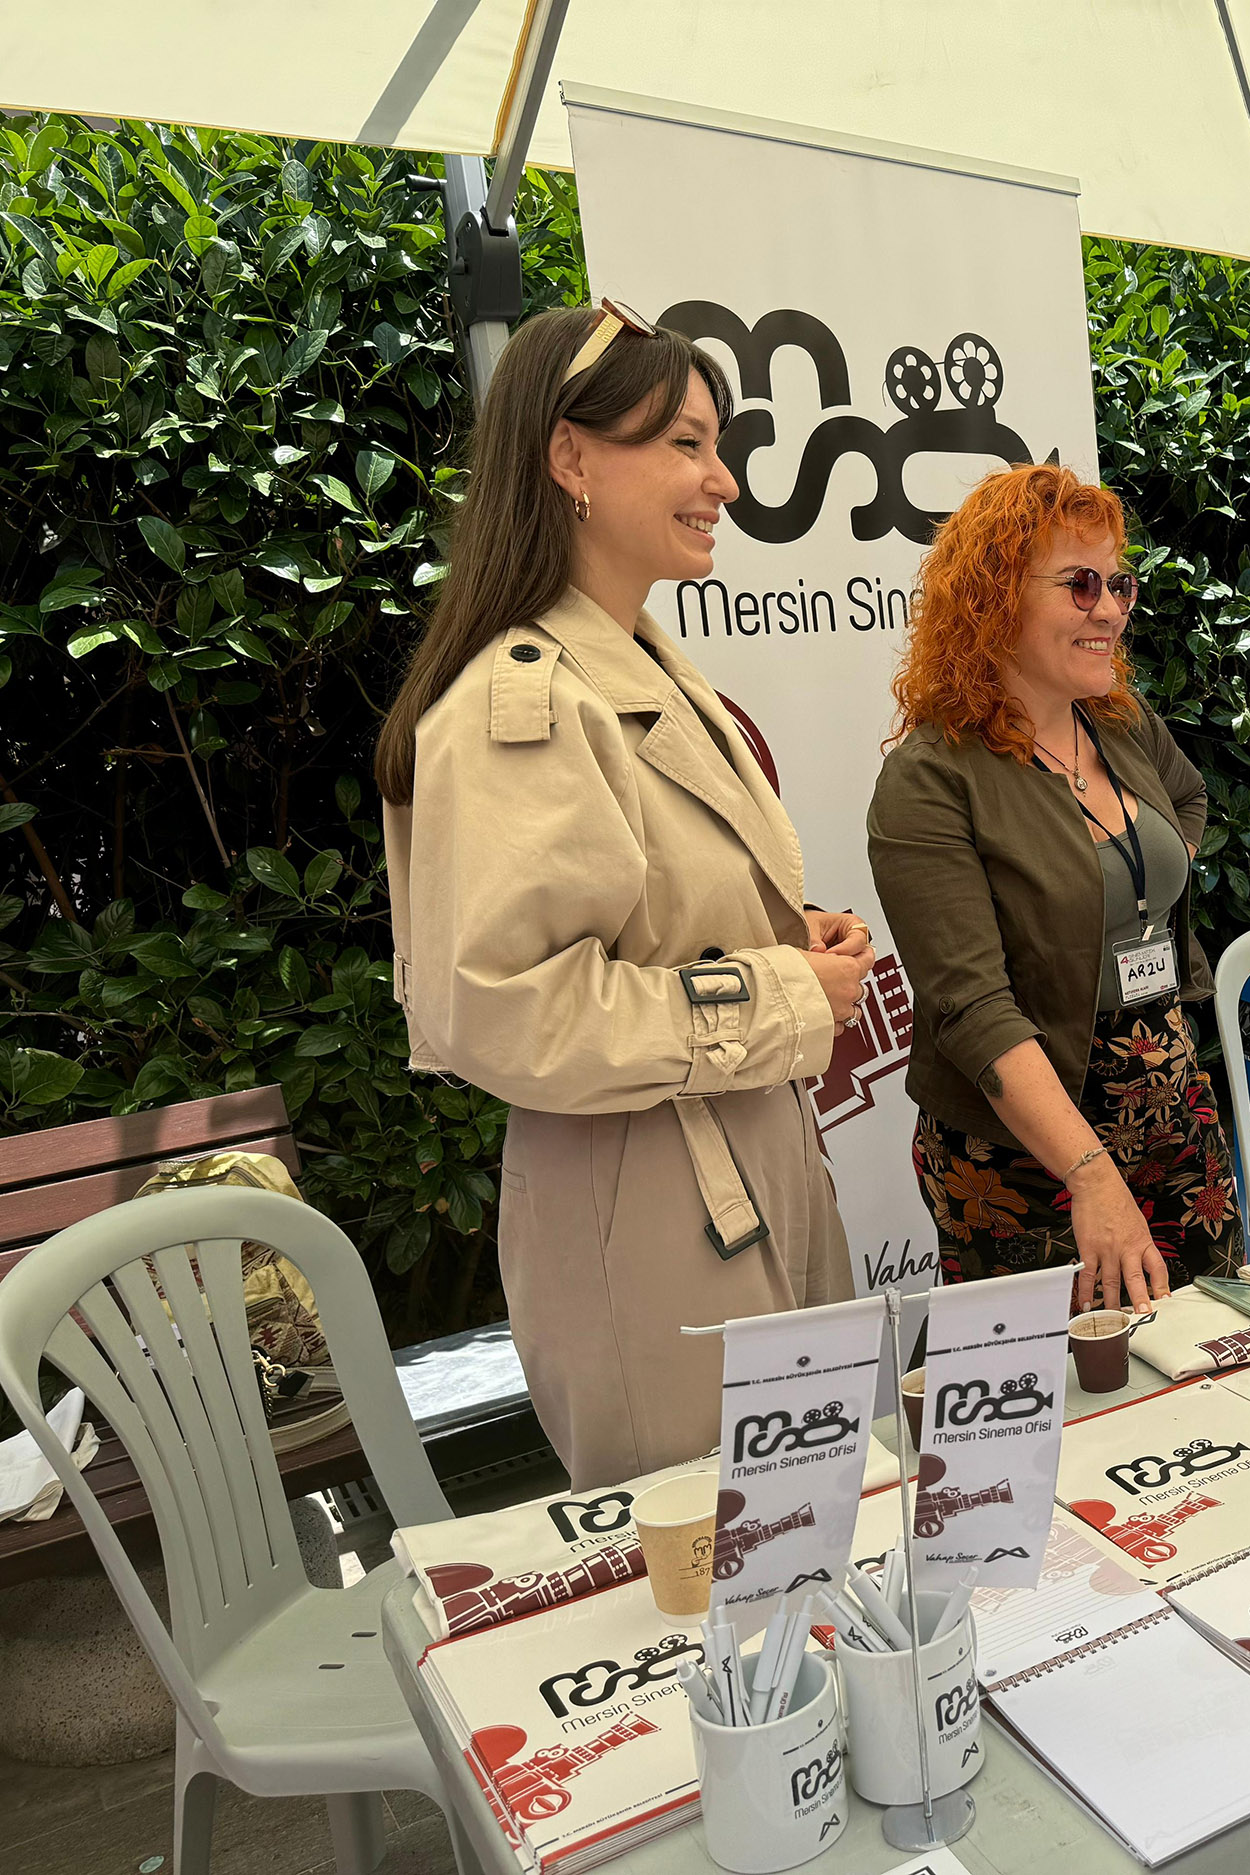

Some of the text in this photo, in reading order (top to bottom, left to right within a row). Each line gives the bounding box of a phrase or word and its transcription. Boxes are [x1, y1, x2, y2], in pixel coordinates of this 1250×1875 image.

[676, 576, 925, 638] Mersin Sine
[933, 1419, 1052, 1444] Mersin Sinema Ofisi
[732, 1442, 857, 1480] Mersin Sinema Ofisi
[1139, 1485, 1191, 1506] Mersin
[1188, 1469, 1239, 1488] Sinema
[561, 1682, 684, 1734] Mersin Sine
[938, 1726, 962, 1744] Mersin
[794, 1799, 821, 1820] Mersin
